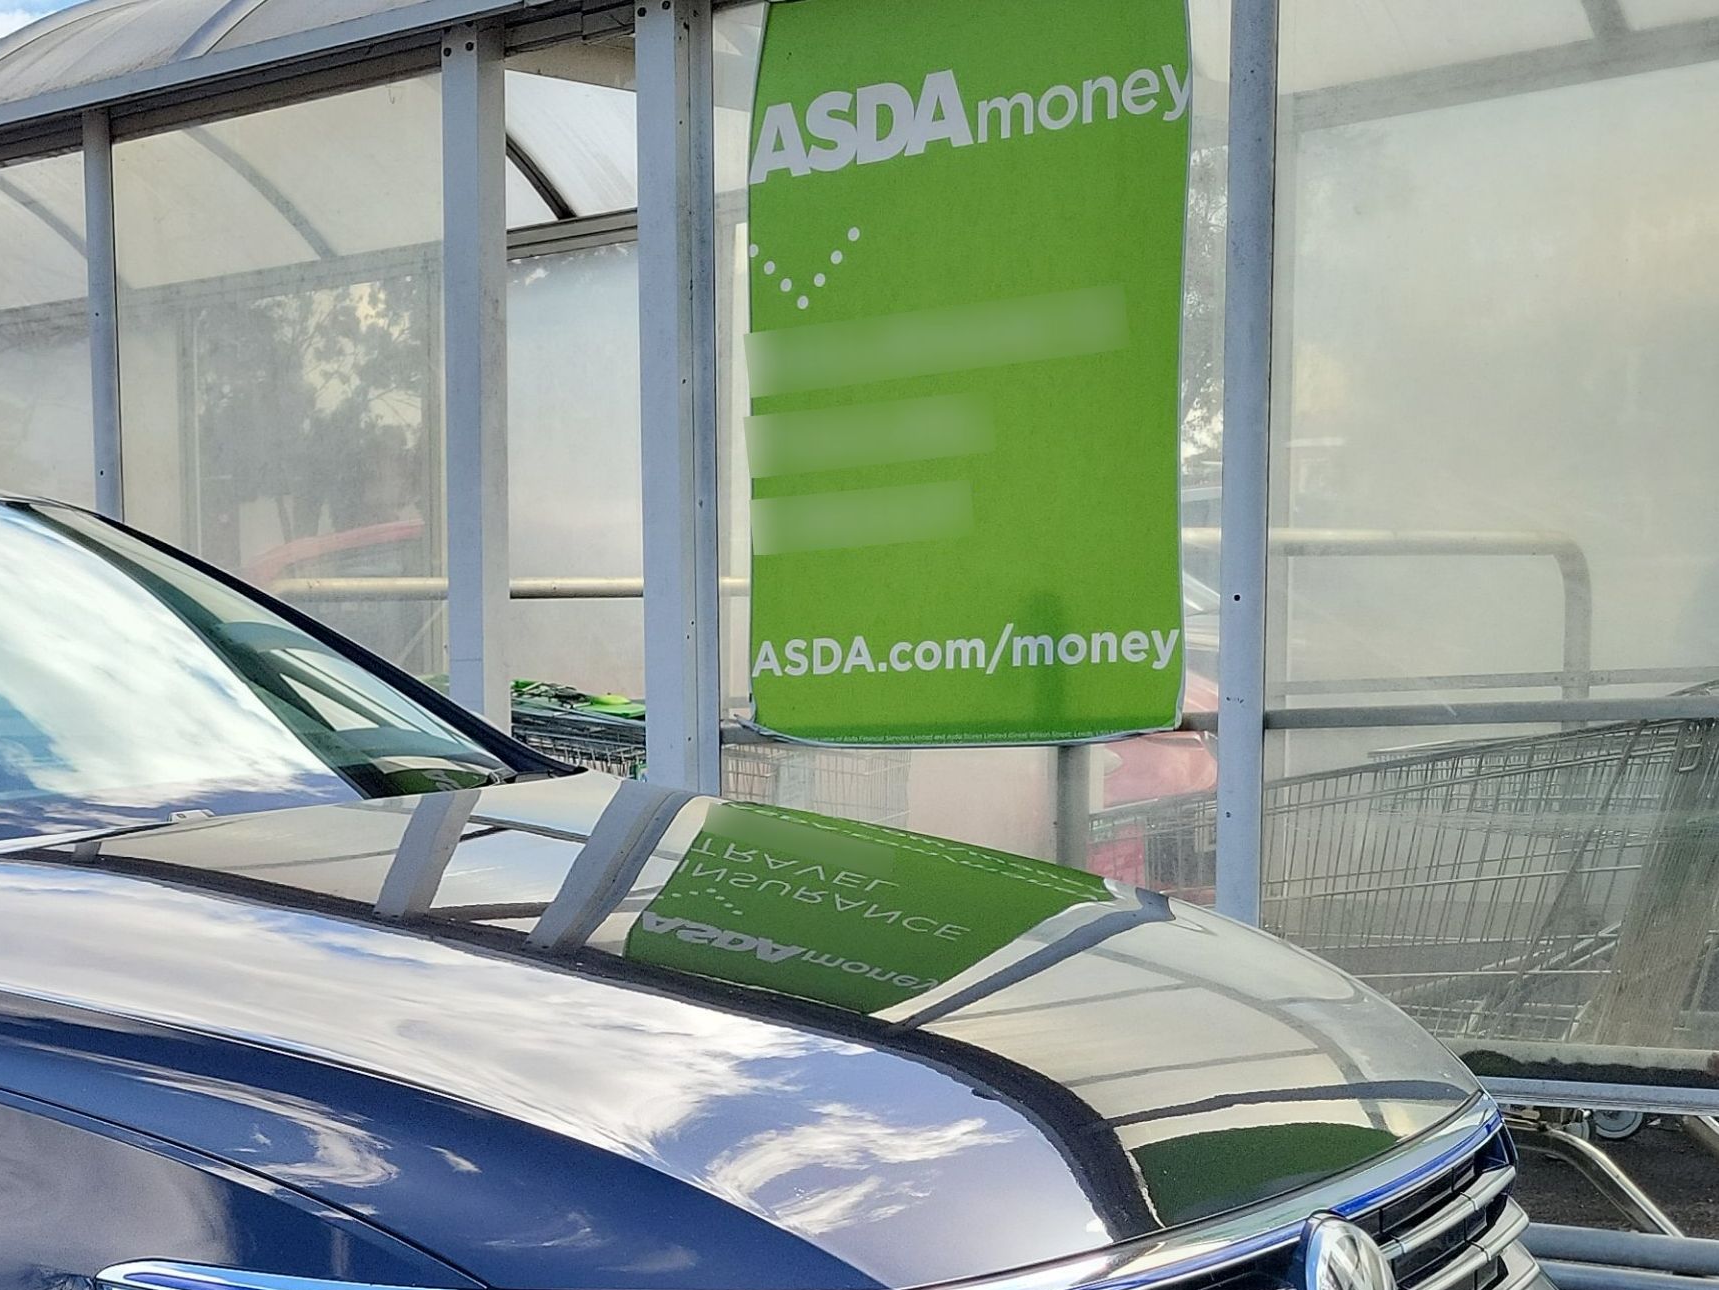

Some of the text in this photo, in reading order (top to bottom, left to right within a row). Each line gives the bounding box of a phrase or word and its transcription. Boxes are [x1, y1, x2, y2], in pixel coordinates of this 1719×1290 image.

[750, 63, 1191, 185] ASDA money
[751, 622, 1180, 678] ASDA.com/money
